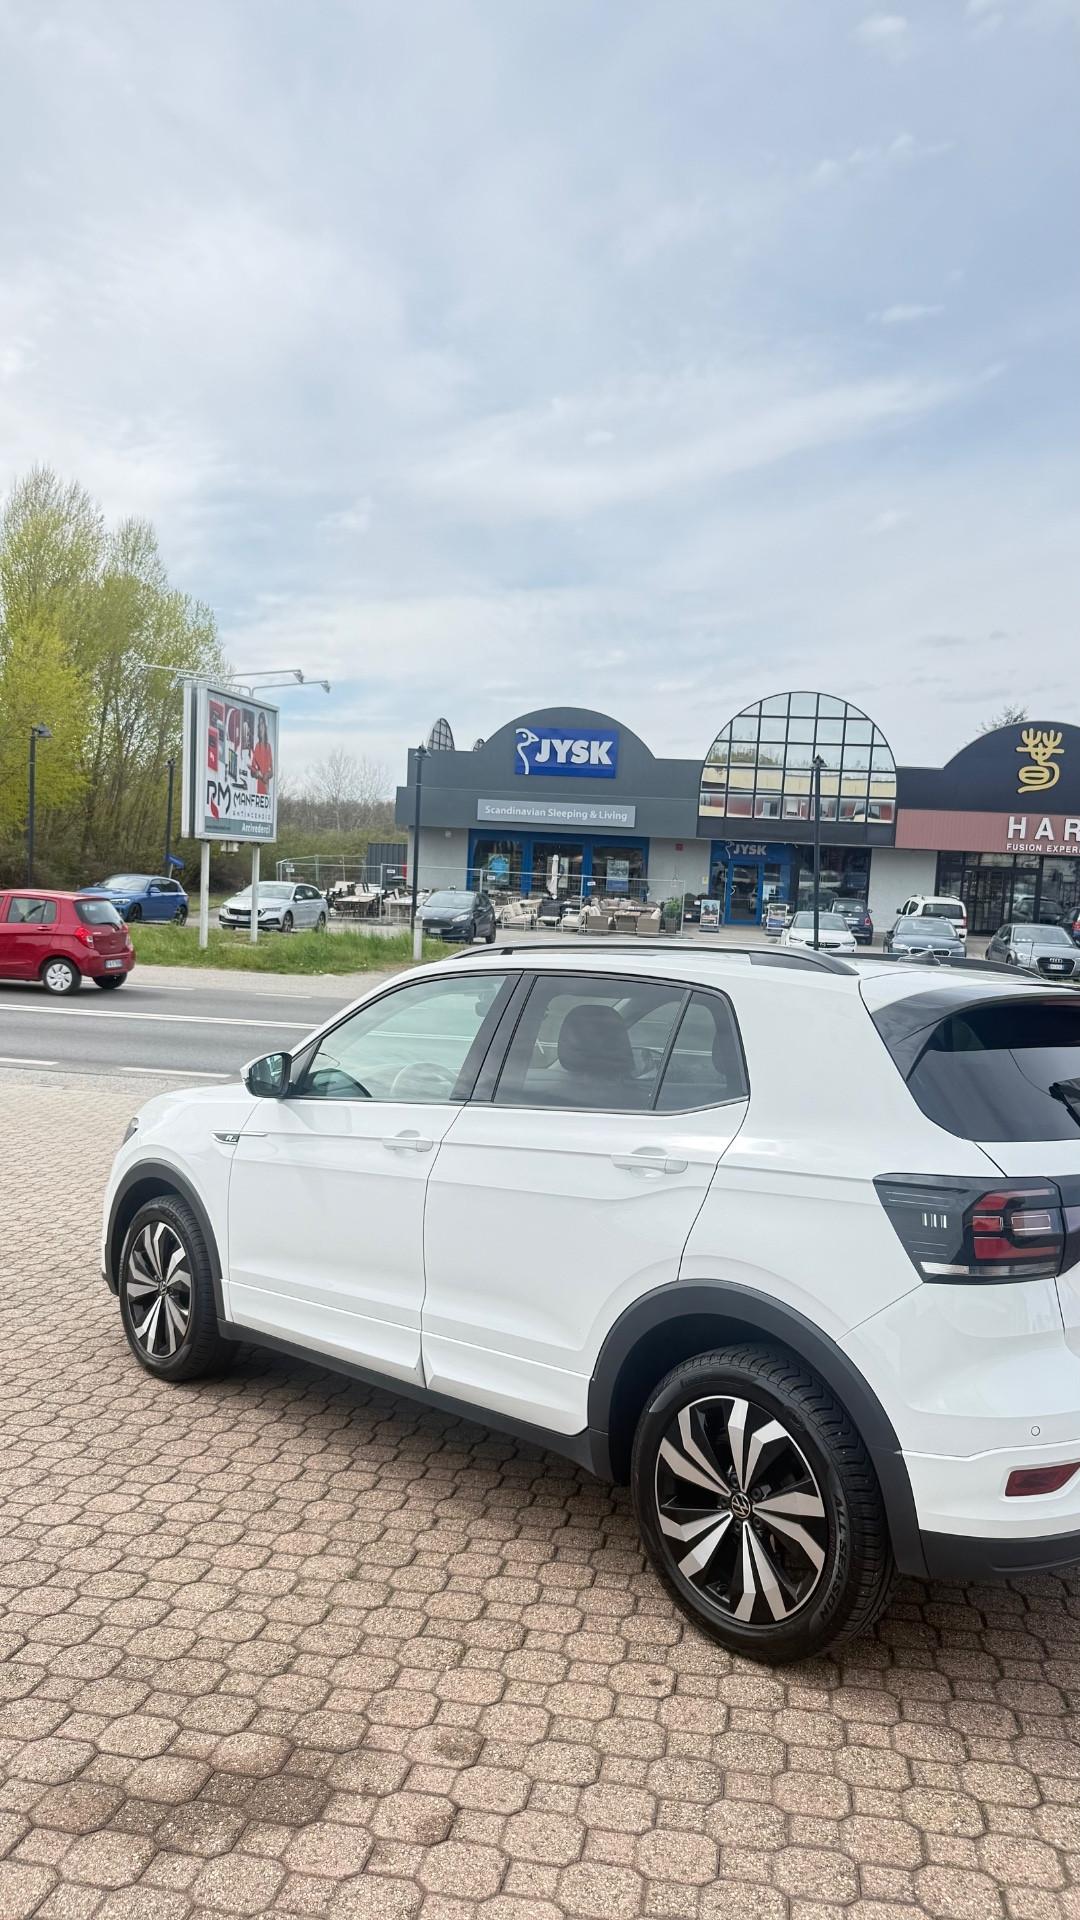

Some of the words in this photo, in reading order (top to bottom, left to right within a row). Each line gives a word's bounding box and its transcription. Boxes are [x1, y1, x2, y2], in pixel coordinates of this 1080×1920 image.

[535, 739, 613, 765] JYSK
[485, 805, 546, 817] Scandinavian
[548, 808, 588, 821] Sleeping
[590, 811, 598, 819] &
[599, 811, 628, 822] Living
[1007, 816, 1080, 842] HAR
[733, 844, 767, 856] JYSK
[1006, 843, 1042, 852] FUSION
[833, 1494, 847, 1534] ALL
